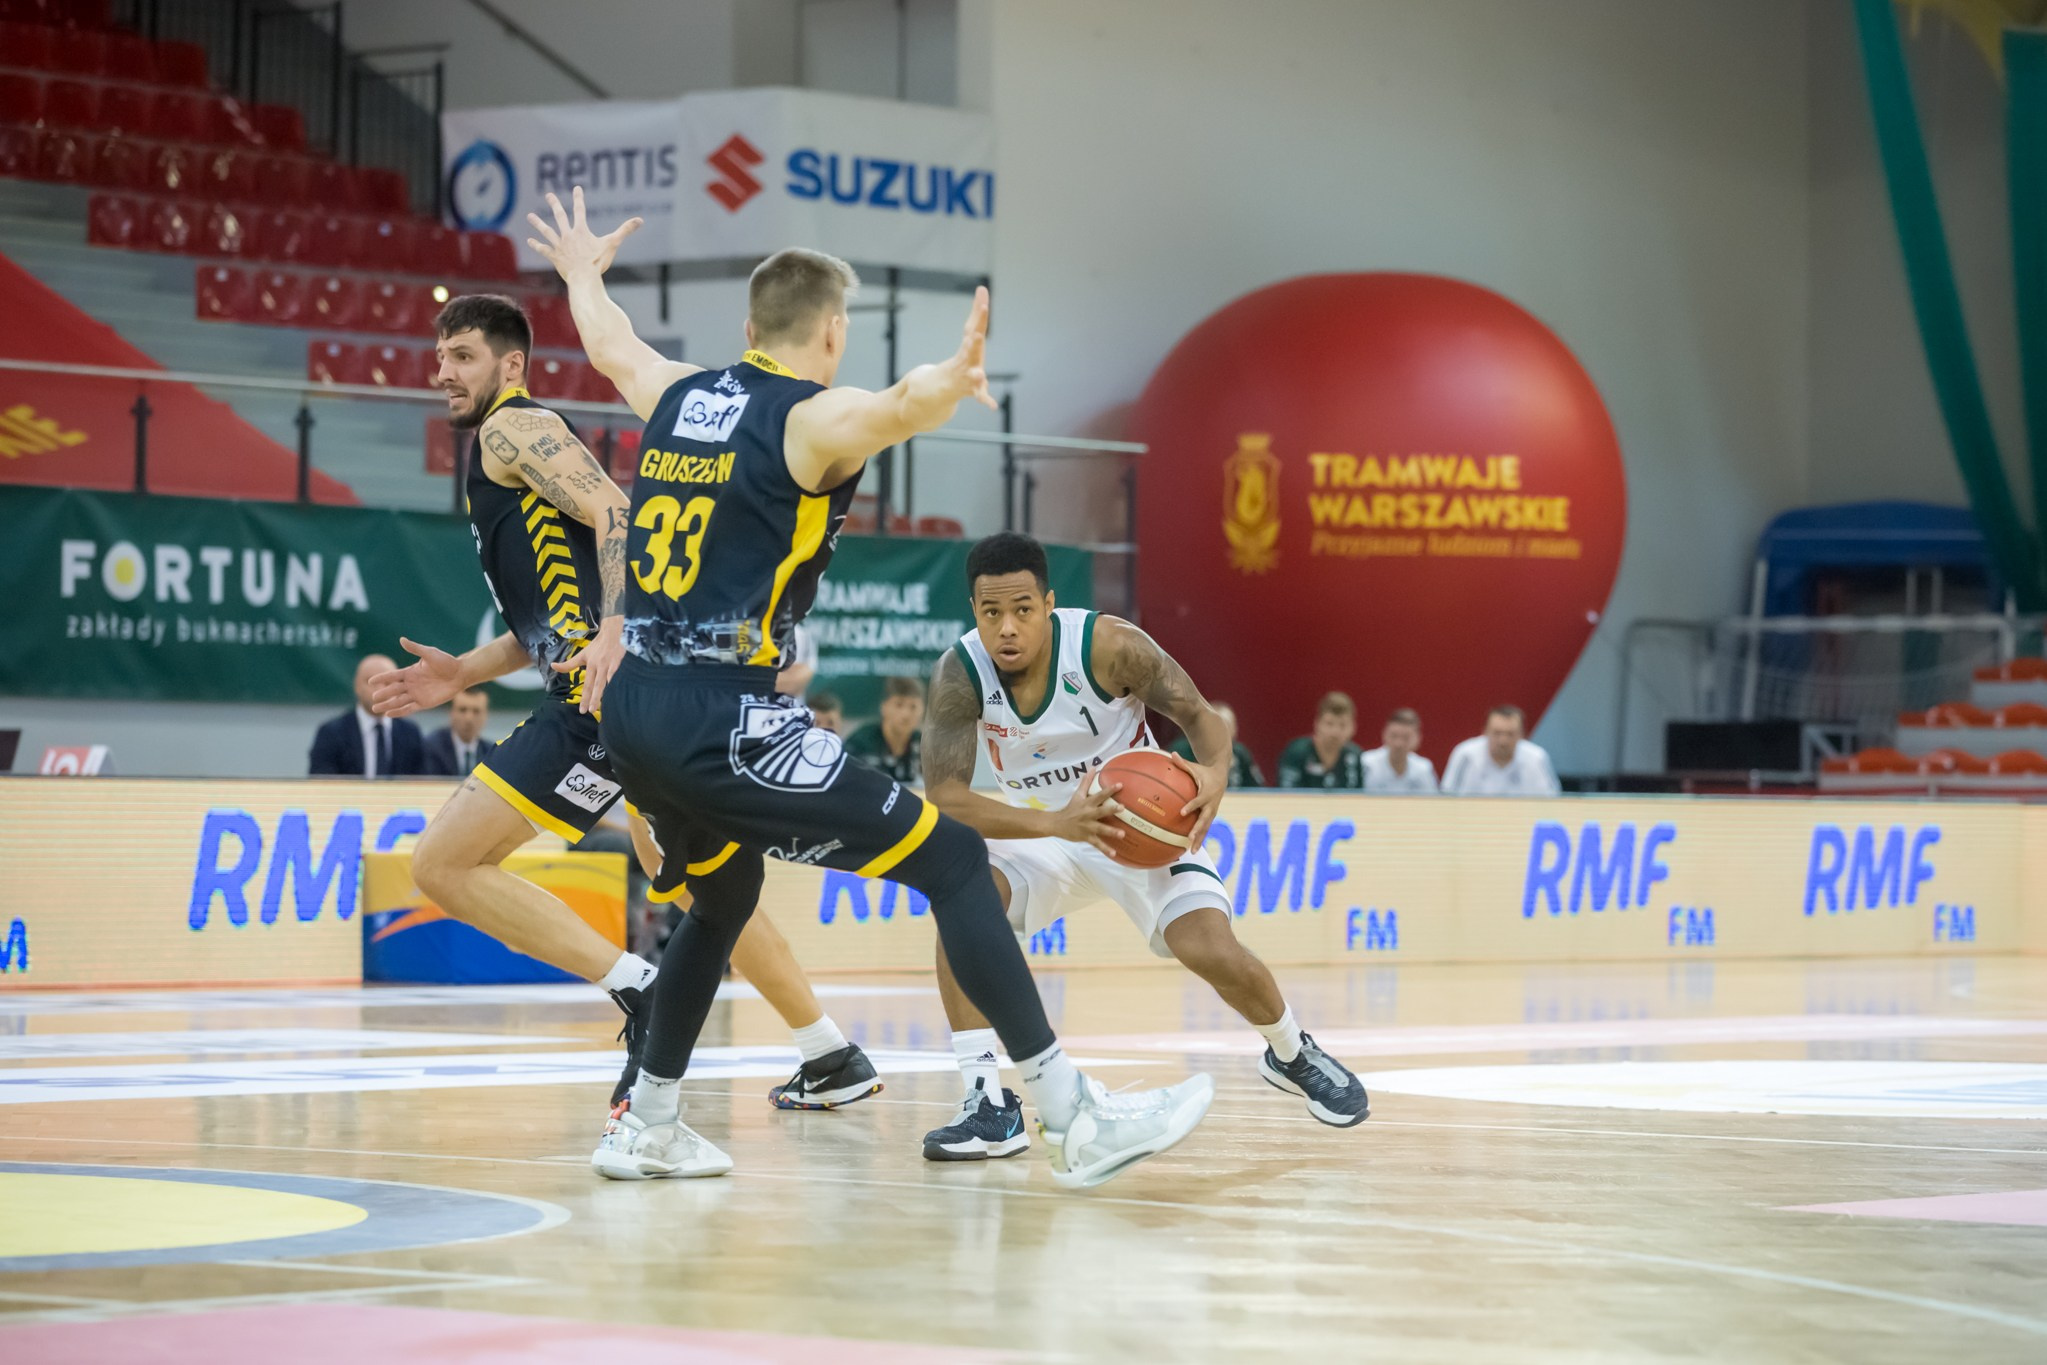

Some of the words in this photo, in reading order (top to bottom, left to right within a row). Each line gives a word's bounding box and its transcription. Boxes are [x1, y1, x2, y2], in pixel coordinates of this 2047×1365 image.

[786, 148, 993, 219] SUZUKI
[1308, 453, 1521, 489] TRAMWAJE
[1308, 493, 1570, 531] WARSZAWSKIE
[630, 495, 716, 602] 33
[60, 539, 370, 612] FORTUNA
[816, 579, 930, 615] RAMWAJE
[1079, 706, 1099, 737] 1
[581, 783, 611, 804] Trefl
[1522, 819, 1677, 918] RMF
[1803, 822, 1941, 917] RMF
[1347, 906, 1398, 950] FM
[1667, 906, 1714, 946] FM
[1933, 903, 1975, 942] FM
